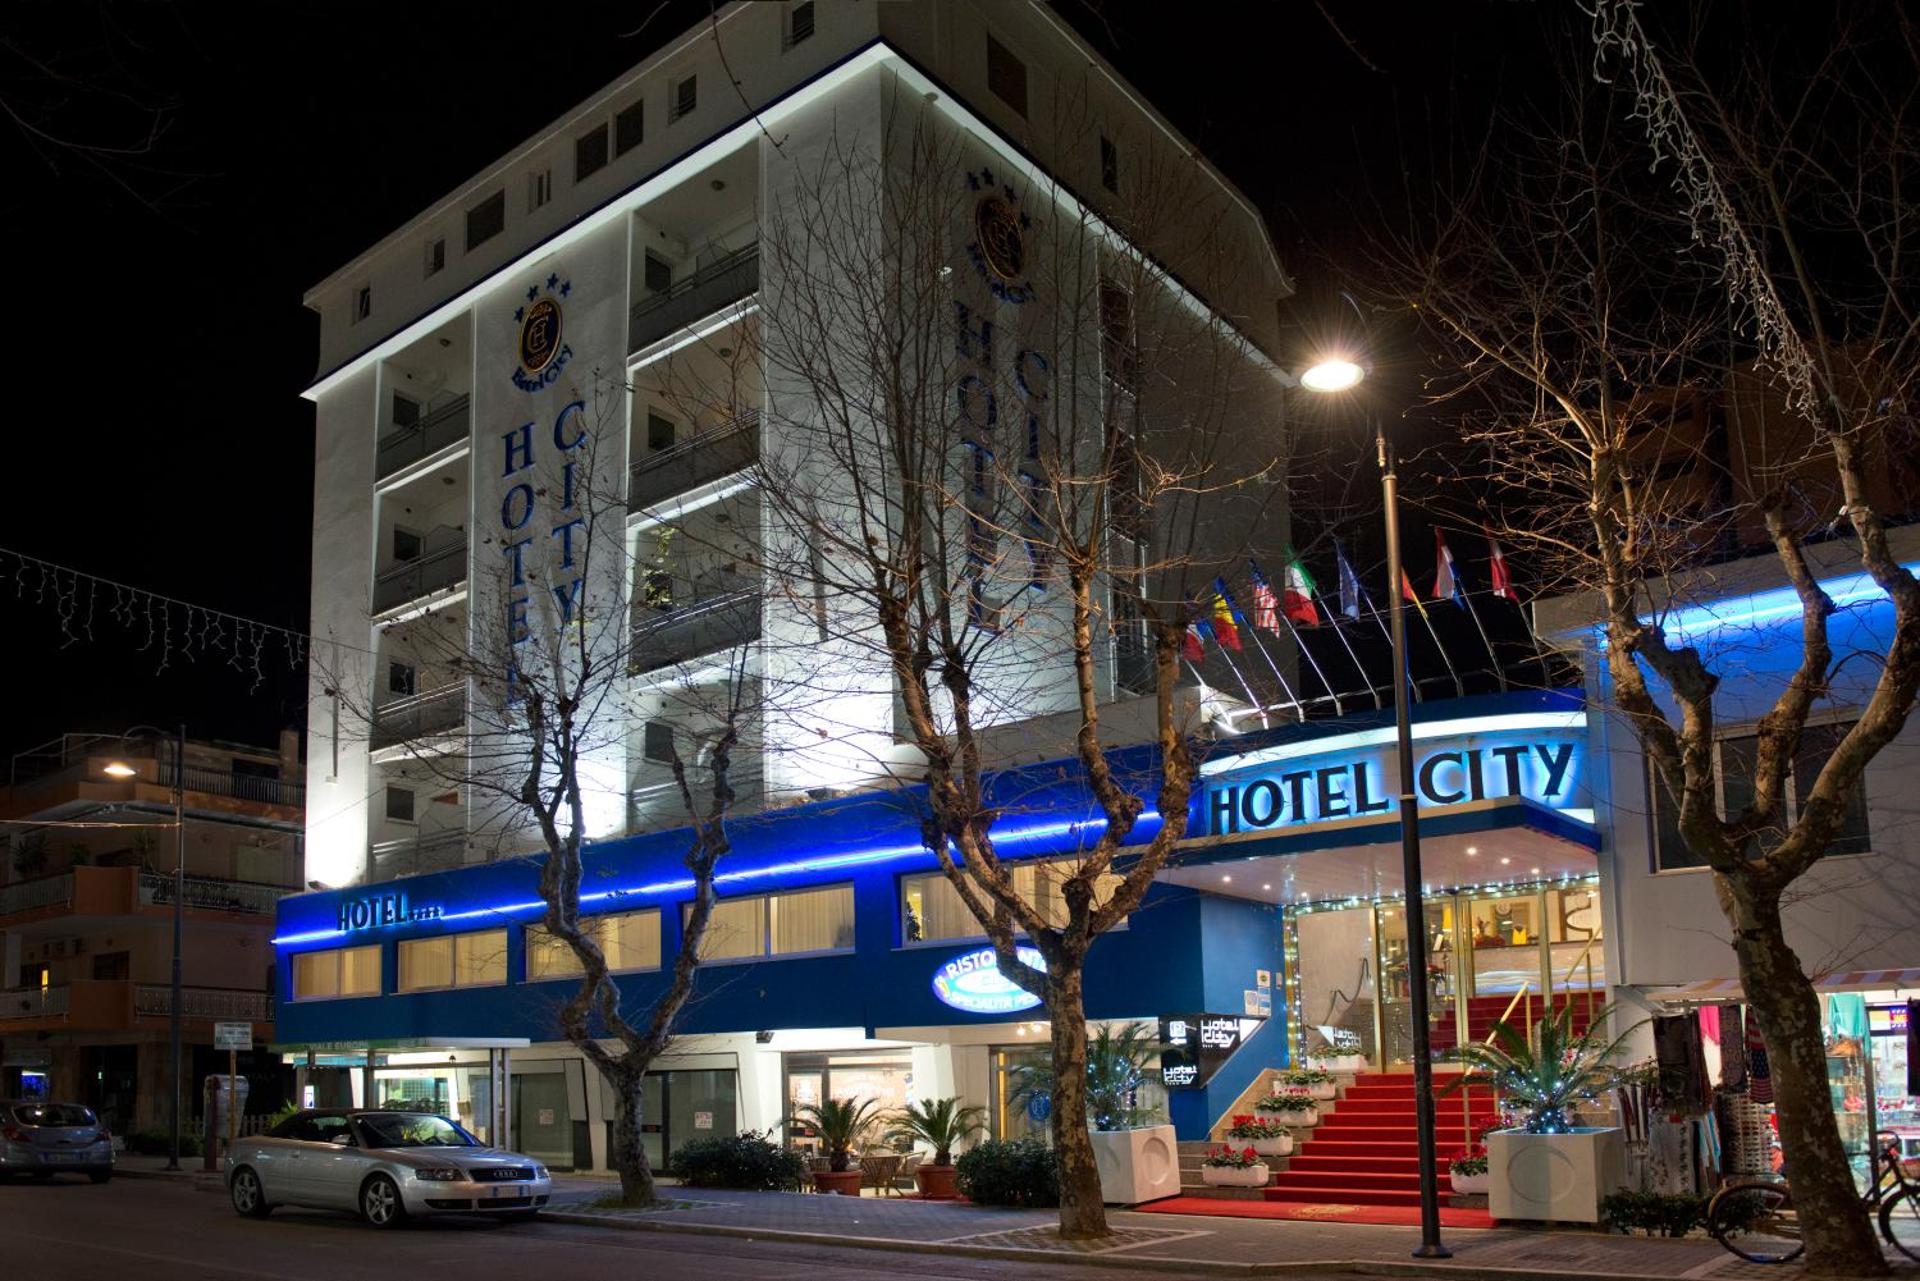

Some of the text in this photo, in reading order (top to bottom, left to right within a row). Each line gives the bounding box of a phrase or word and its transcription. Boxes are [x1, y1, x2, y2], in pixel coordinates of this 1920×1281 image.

[553, 400, 586, 621] CITY
[1210, 743, 1574, 836] HOTEL CITY
[336, 892, 407, 931] HOTEL
